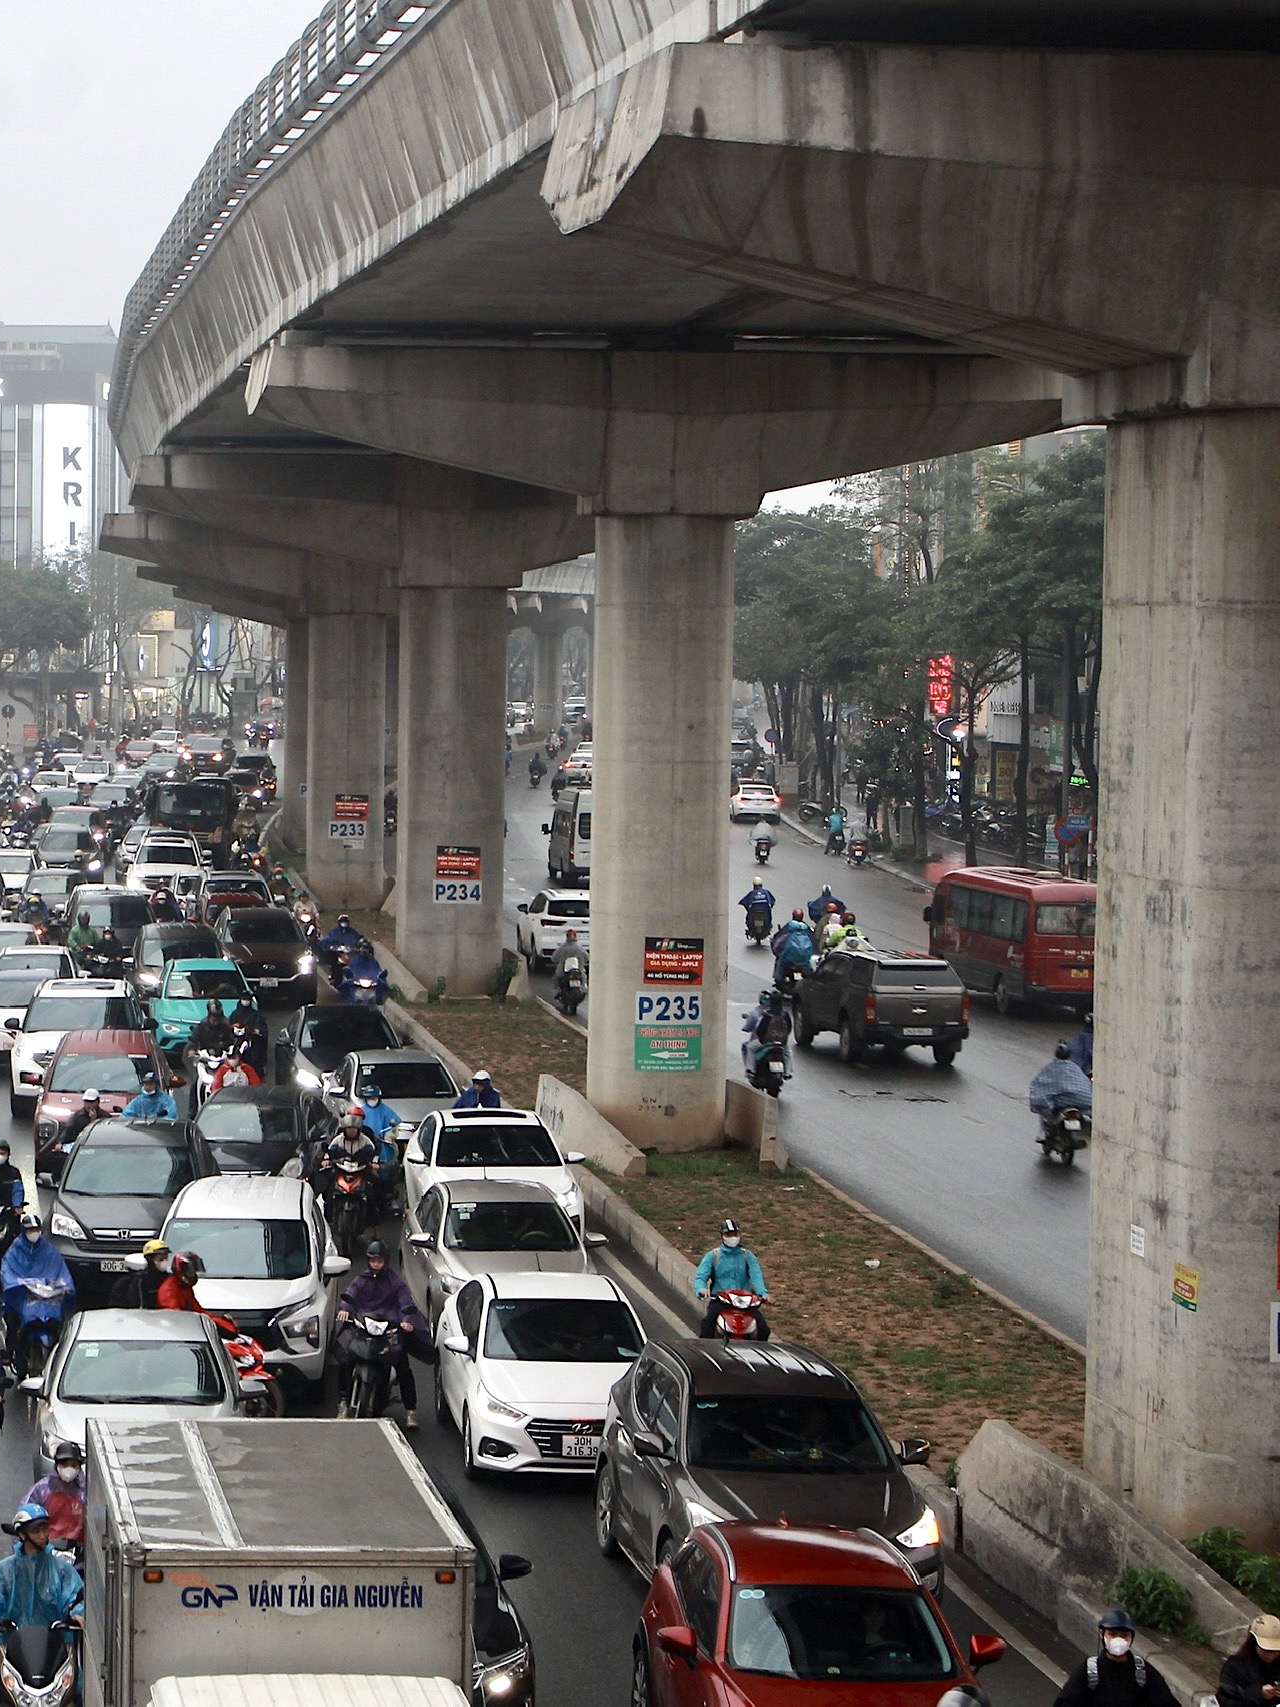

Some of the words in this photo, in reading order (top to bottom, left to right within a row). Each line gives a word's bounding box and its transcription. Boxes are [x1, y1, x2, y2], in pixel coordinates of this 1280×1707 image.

[330, 824, 365, 837] P233
[435, 884, 481, 901] P234
[646, 952, 660, 960] ĐIỆN
[661, 953, 679, 961] THOẠI
[638, 995, 700, 1021] P235
[650, 1040, 662, 1049] AN
[664, 1040, 687, 1050] THỊNH
[574, 1436, 592, 1446] 30H
[566, 1446, 599, 1457] 216.39
[181, 1584, 239, 1609] GNP
[248, 1580, 283, 1612] VẬN
[288, 1575, 314, 1608] TẢI
[320, 1584, 348, 1608] GIA
[354, 1576, 423, 1608] NGUYỄN
